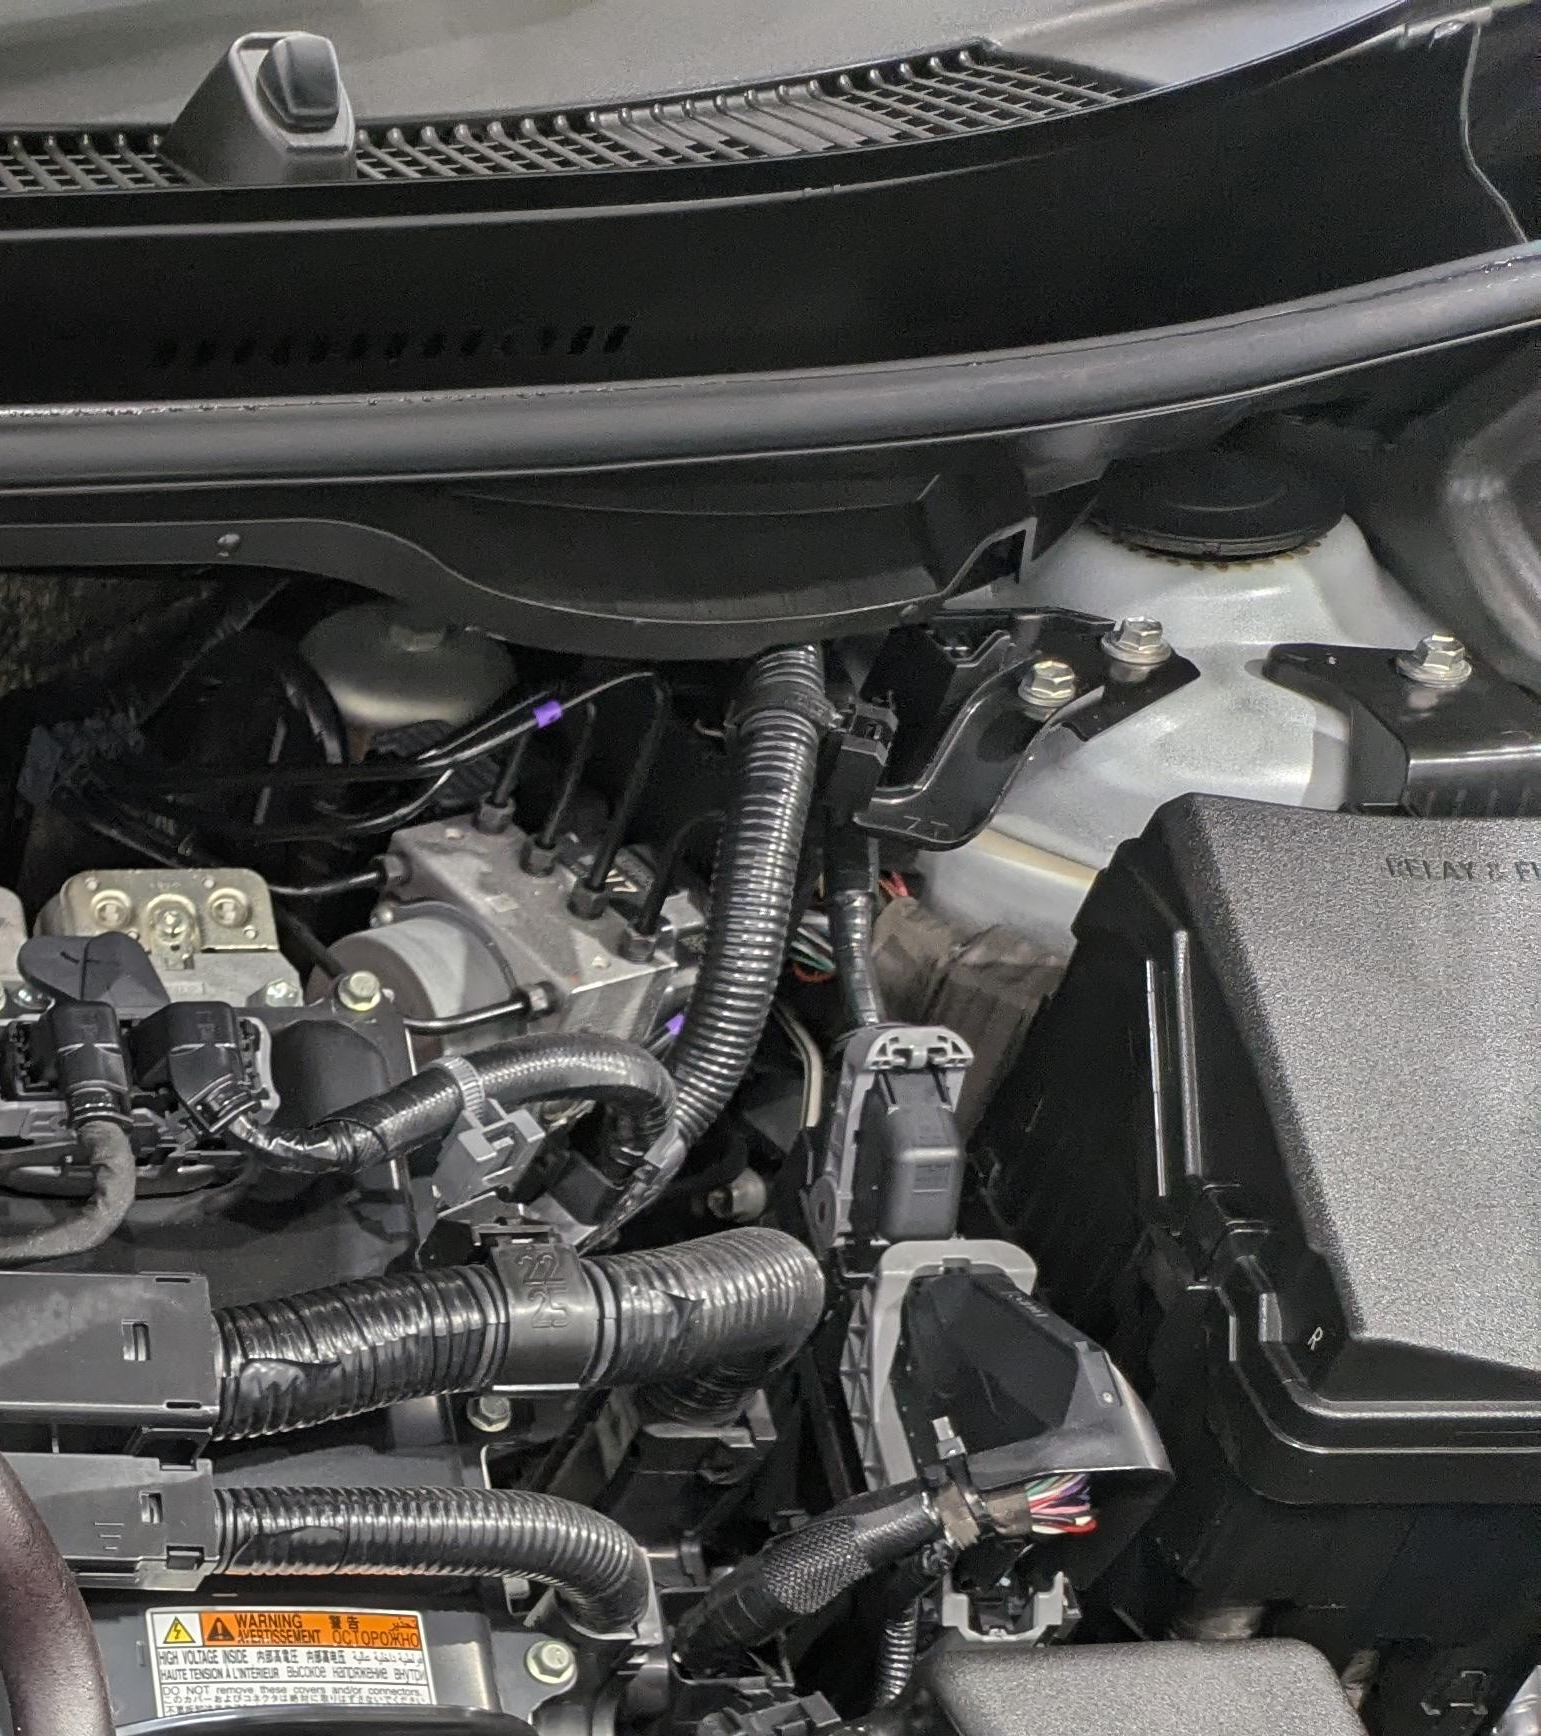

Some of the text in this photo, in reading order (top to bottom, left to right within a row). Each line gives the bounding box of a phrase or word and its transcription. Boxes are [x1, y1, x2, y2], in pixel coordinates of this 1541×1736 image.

[1386, 858, 1473, 880] RELAY
[234, 1613, 303, 1629] WARNING
[237, 1629, 322, 1644] AVERTISSEMENT
[332, 1629, 420, 1648] ОСТОРОЖНО
[159, 1649, 249, 1665] HIGH VOLTAGE INSIDE
[160, 1668, 188, 1681] HAUTE
[189, 1667, 224, 1680] TENSION
[163, 1686, 180, 1696] DO
[186, 1686, 210, 1695] NOT
[216, 1686, 254, 1695] remove
[259, 1686, 287, 1695] these
[293, 1686, 326, 1695] covers
[332, 1686, 363, 1696] and/or
